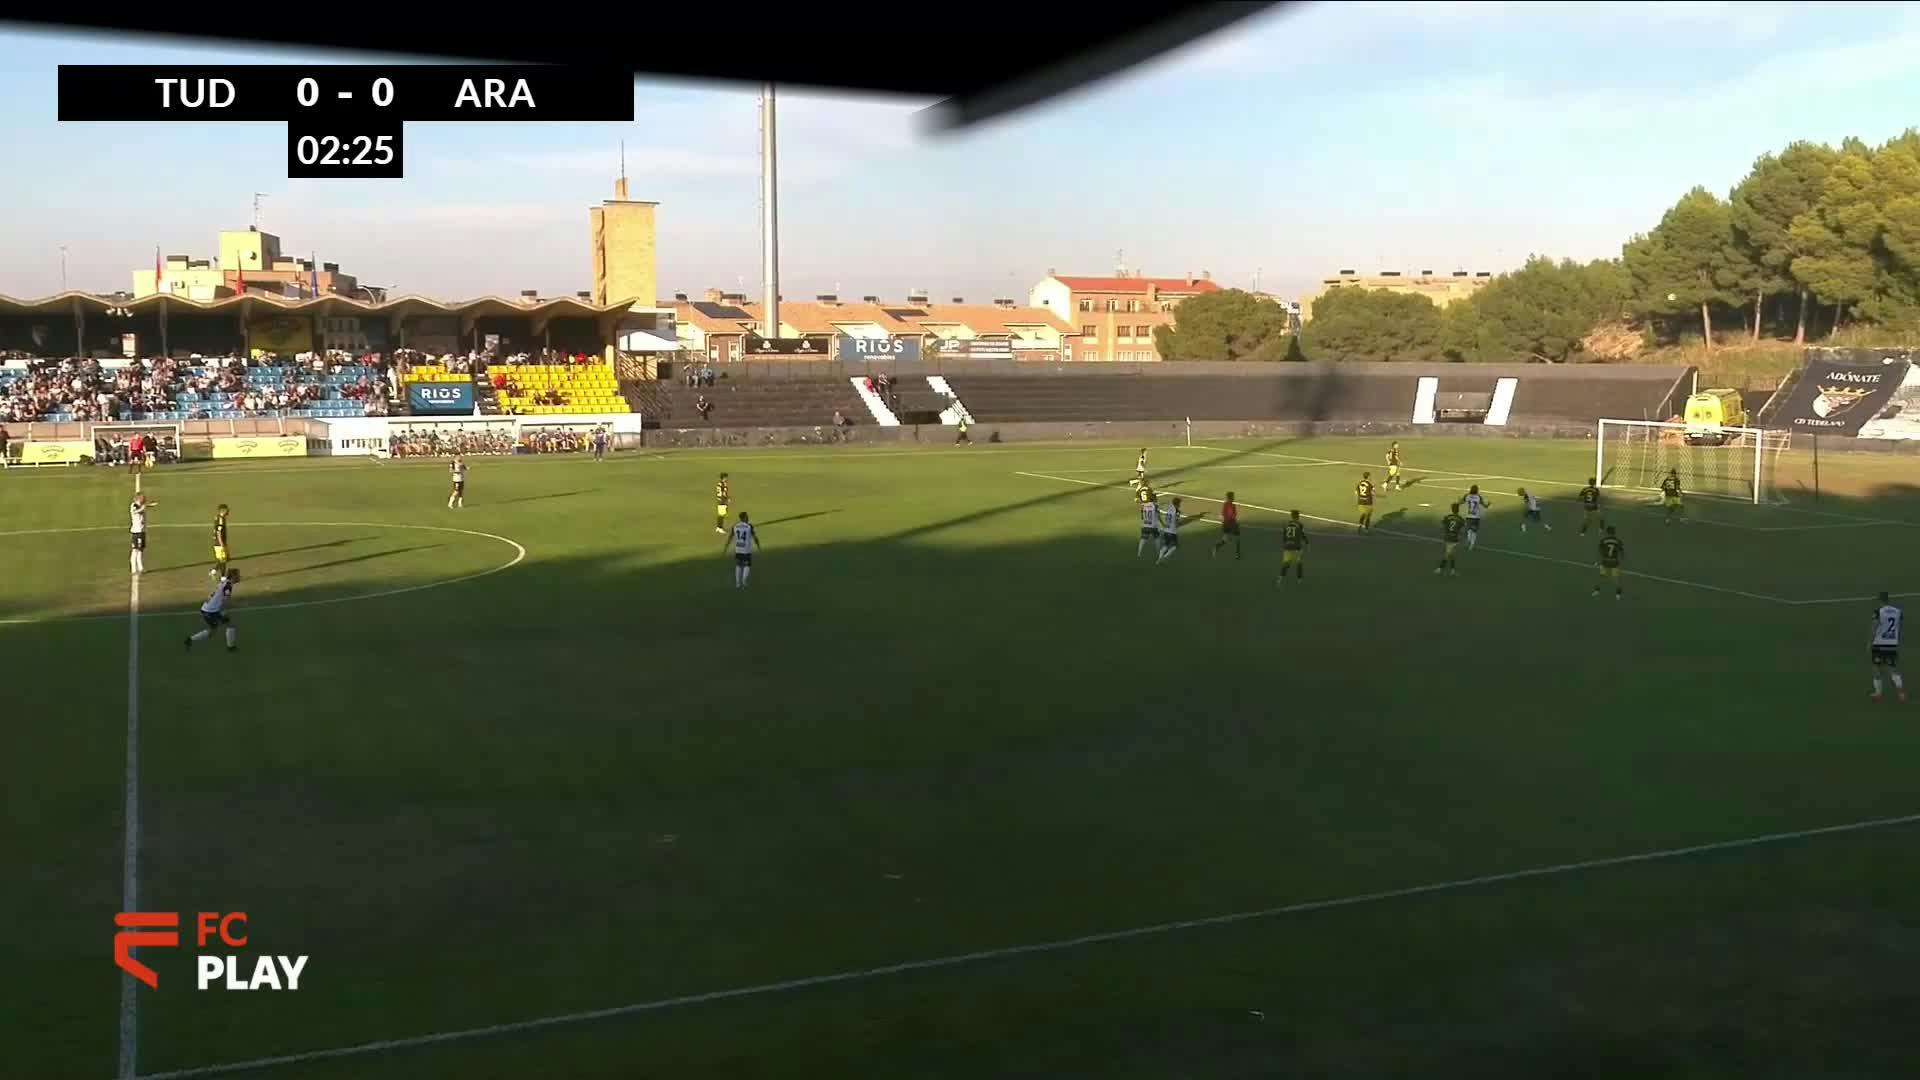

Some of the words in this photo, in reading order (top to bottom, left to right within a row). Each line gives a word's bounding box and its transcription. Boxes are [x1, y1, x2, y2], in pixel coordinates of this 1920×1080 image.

[735, 529, 747, 541] 14
[1607, 544, 1615, 557] 7
[1887, 617, 1896, 632] 2
